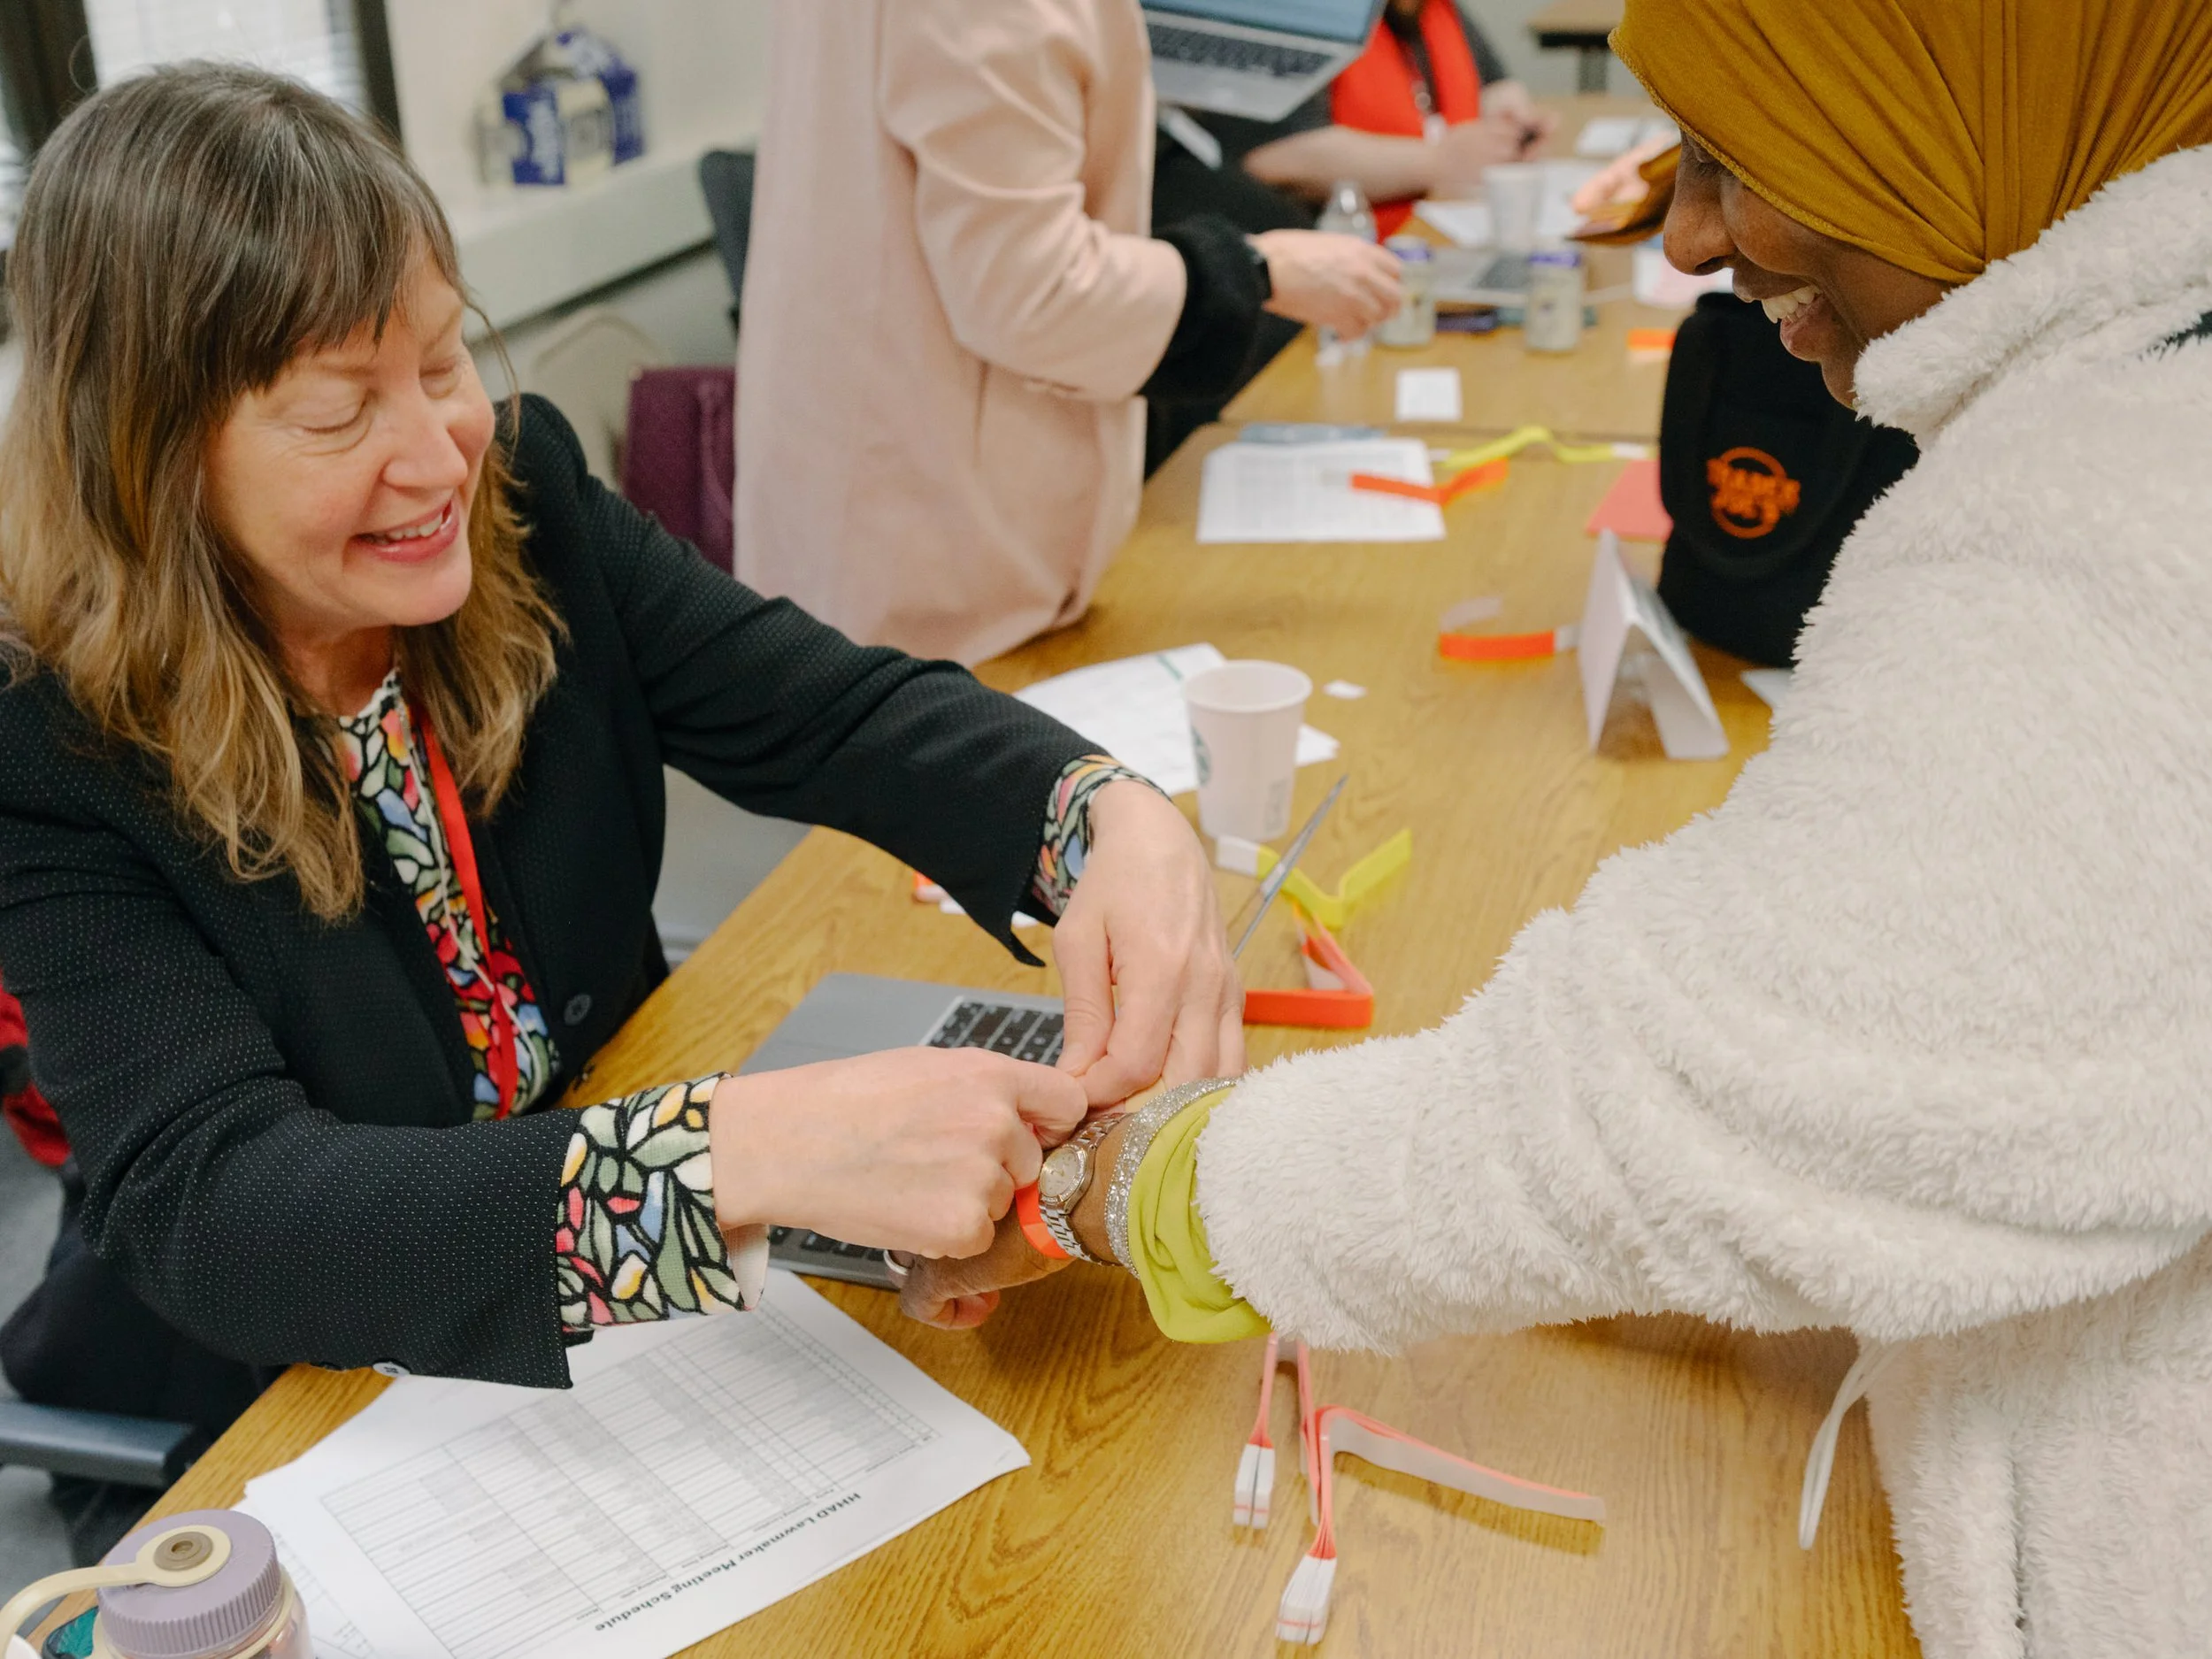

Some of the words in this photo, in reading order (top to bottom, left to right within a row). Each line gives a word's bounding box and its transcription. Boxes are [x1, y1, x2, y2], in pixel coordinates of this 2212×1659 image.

[817, 1492, 861, 1519] HHAD
[738, 1517, 816, 1561] Lawmaker
[670, 1558, 737, 1594] Meeting
[595, 1592, 672, 1631] Schedule
